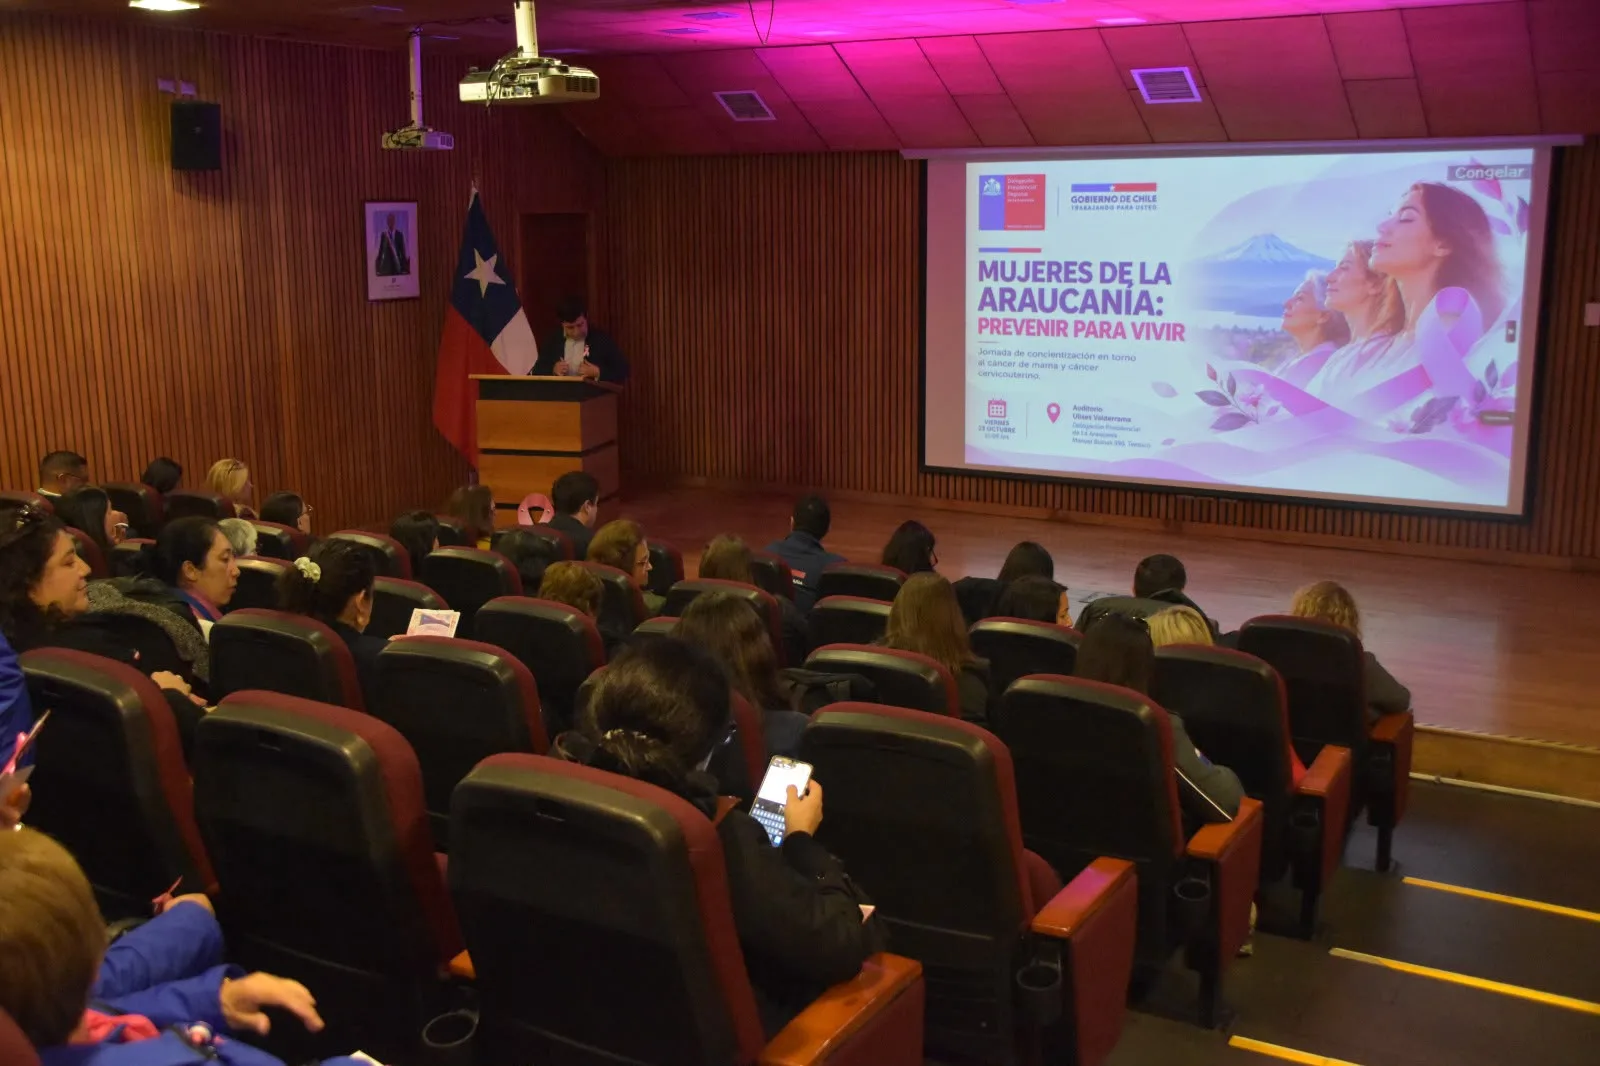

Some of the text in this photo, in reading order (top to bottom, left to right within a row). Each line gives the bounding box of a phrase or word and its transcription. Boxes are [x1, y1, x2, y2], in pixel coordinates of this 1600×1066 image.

[1456, 166, 1524, 179] Congelar
[1071, 194, 1157, 204] GOBIERNO DE CHILE
[978, 260, 1172, 285] MUJERES DE LA
[977, 282, 1164, 317] ARAUCANÍA:
[977, 317, 1186, 342] PREVENIR PARA VIVIR
[978, 348, 1012, 357] Jornada
[1014, 349, 1025, 357] de
[1027, 350, 1096, 361] concientización
[1111, 353, 1137, 362] torno
[988, 359, 1016, 368] cáncer
[1018, 360, 1029, 368] de
[1032, 362, 1059, 370] mama
[1060, 363, 1067, 371] y
[1068, 362, 1099, 372] cáncer
[1072, 404, 1103, 413] Auditorio
[1072, 413, 1132, 423] Ulises Valderrama
